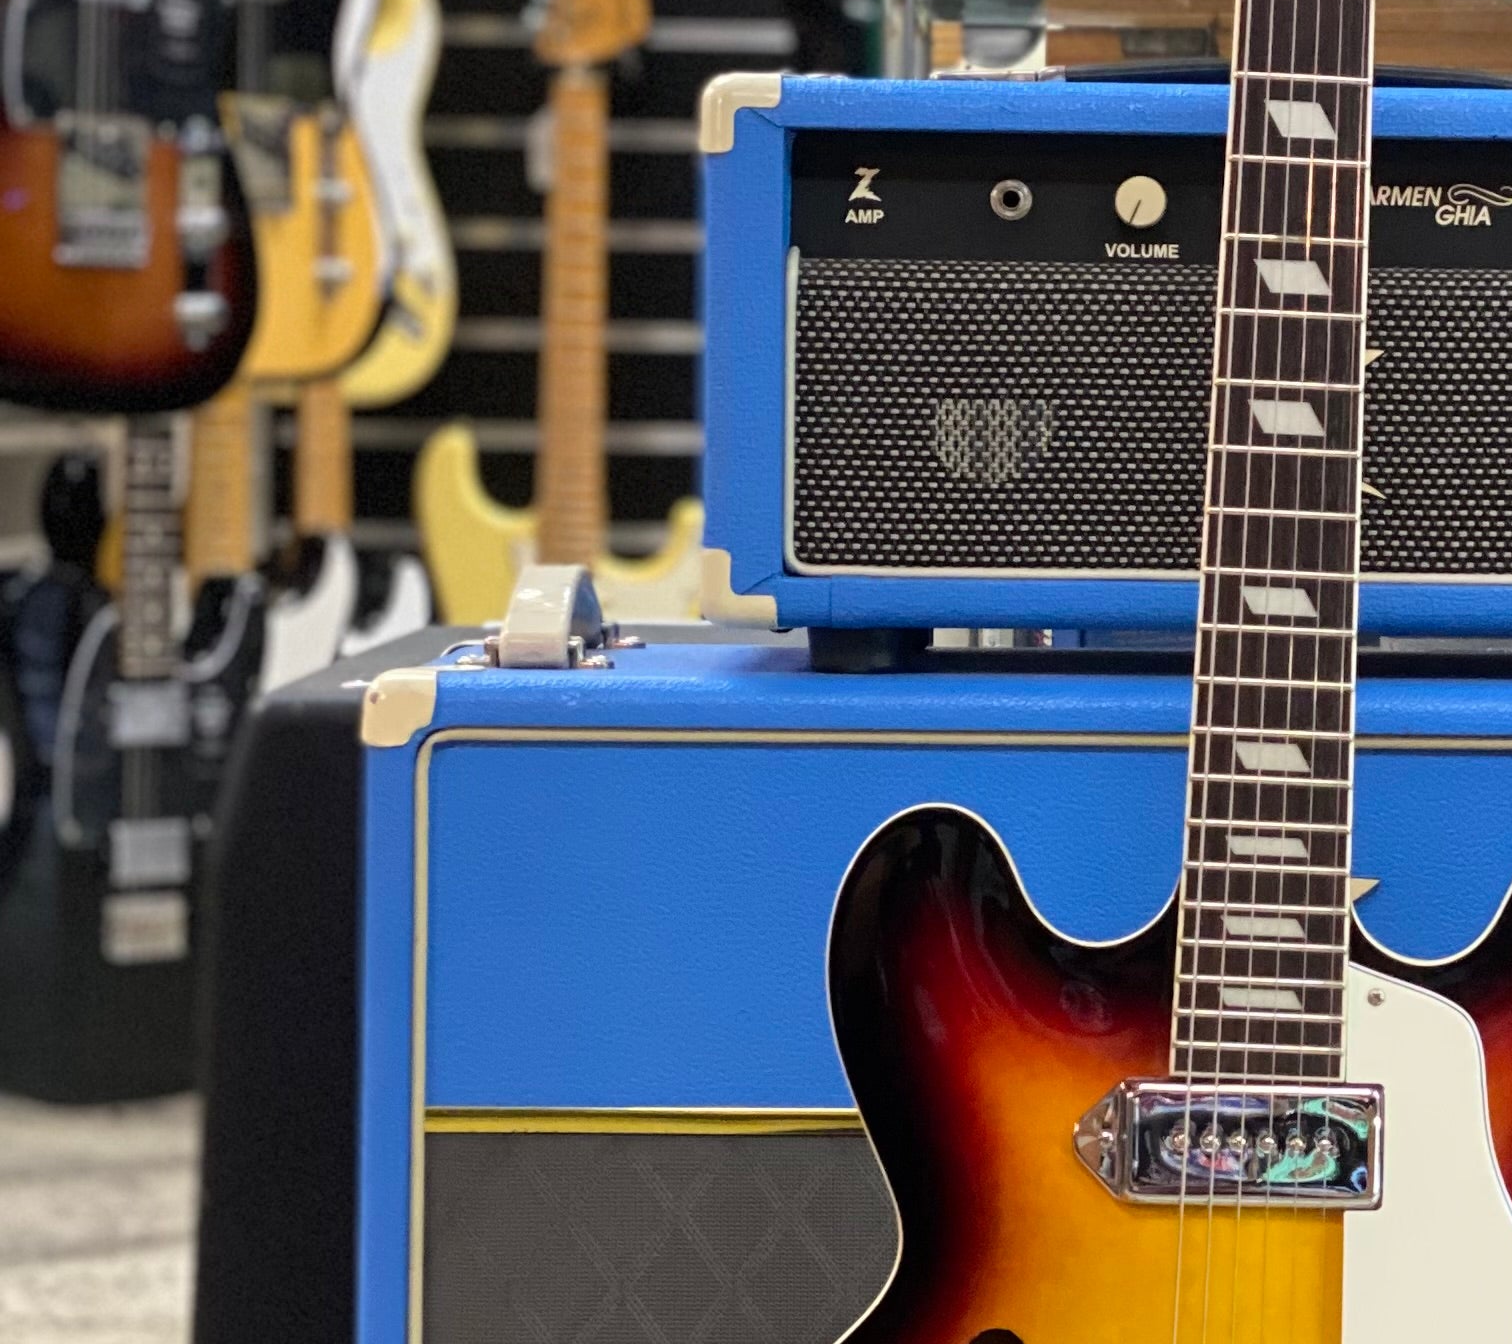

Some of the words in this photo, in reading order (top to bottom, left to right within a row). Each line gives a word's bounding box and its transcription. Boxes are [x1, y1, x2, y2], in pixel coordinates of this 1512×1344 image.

[844, 209, 885, 224] AMP
[1434, 205, 1492, 226] GHIA
[1104, 243, 1180, 258] VOLUME
